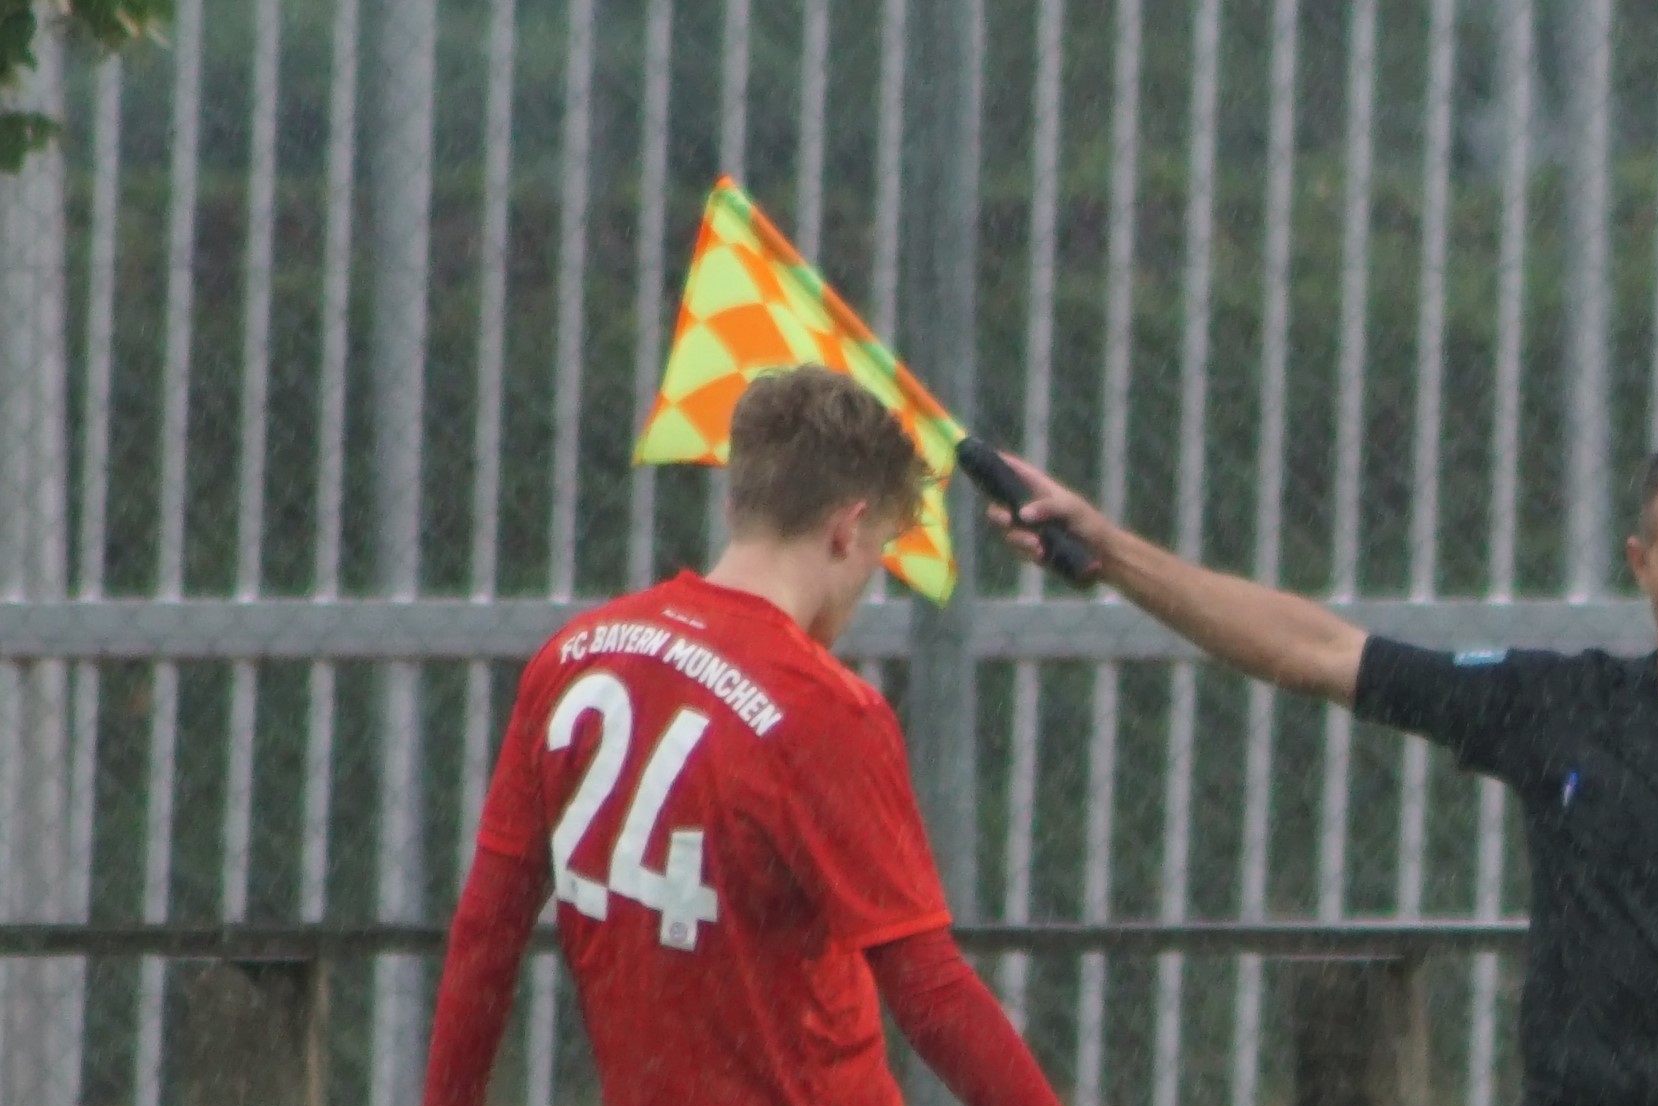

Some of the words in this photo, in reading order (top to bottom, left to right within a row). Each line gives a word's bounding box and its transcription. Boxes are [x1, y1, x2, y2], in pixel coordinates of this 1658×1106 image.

[560, 631, 588, 664] FC
[589, 624, 671, 656] BAYERN
[548, 673, 718, 950] 24
